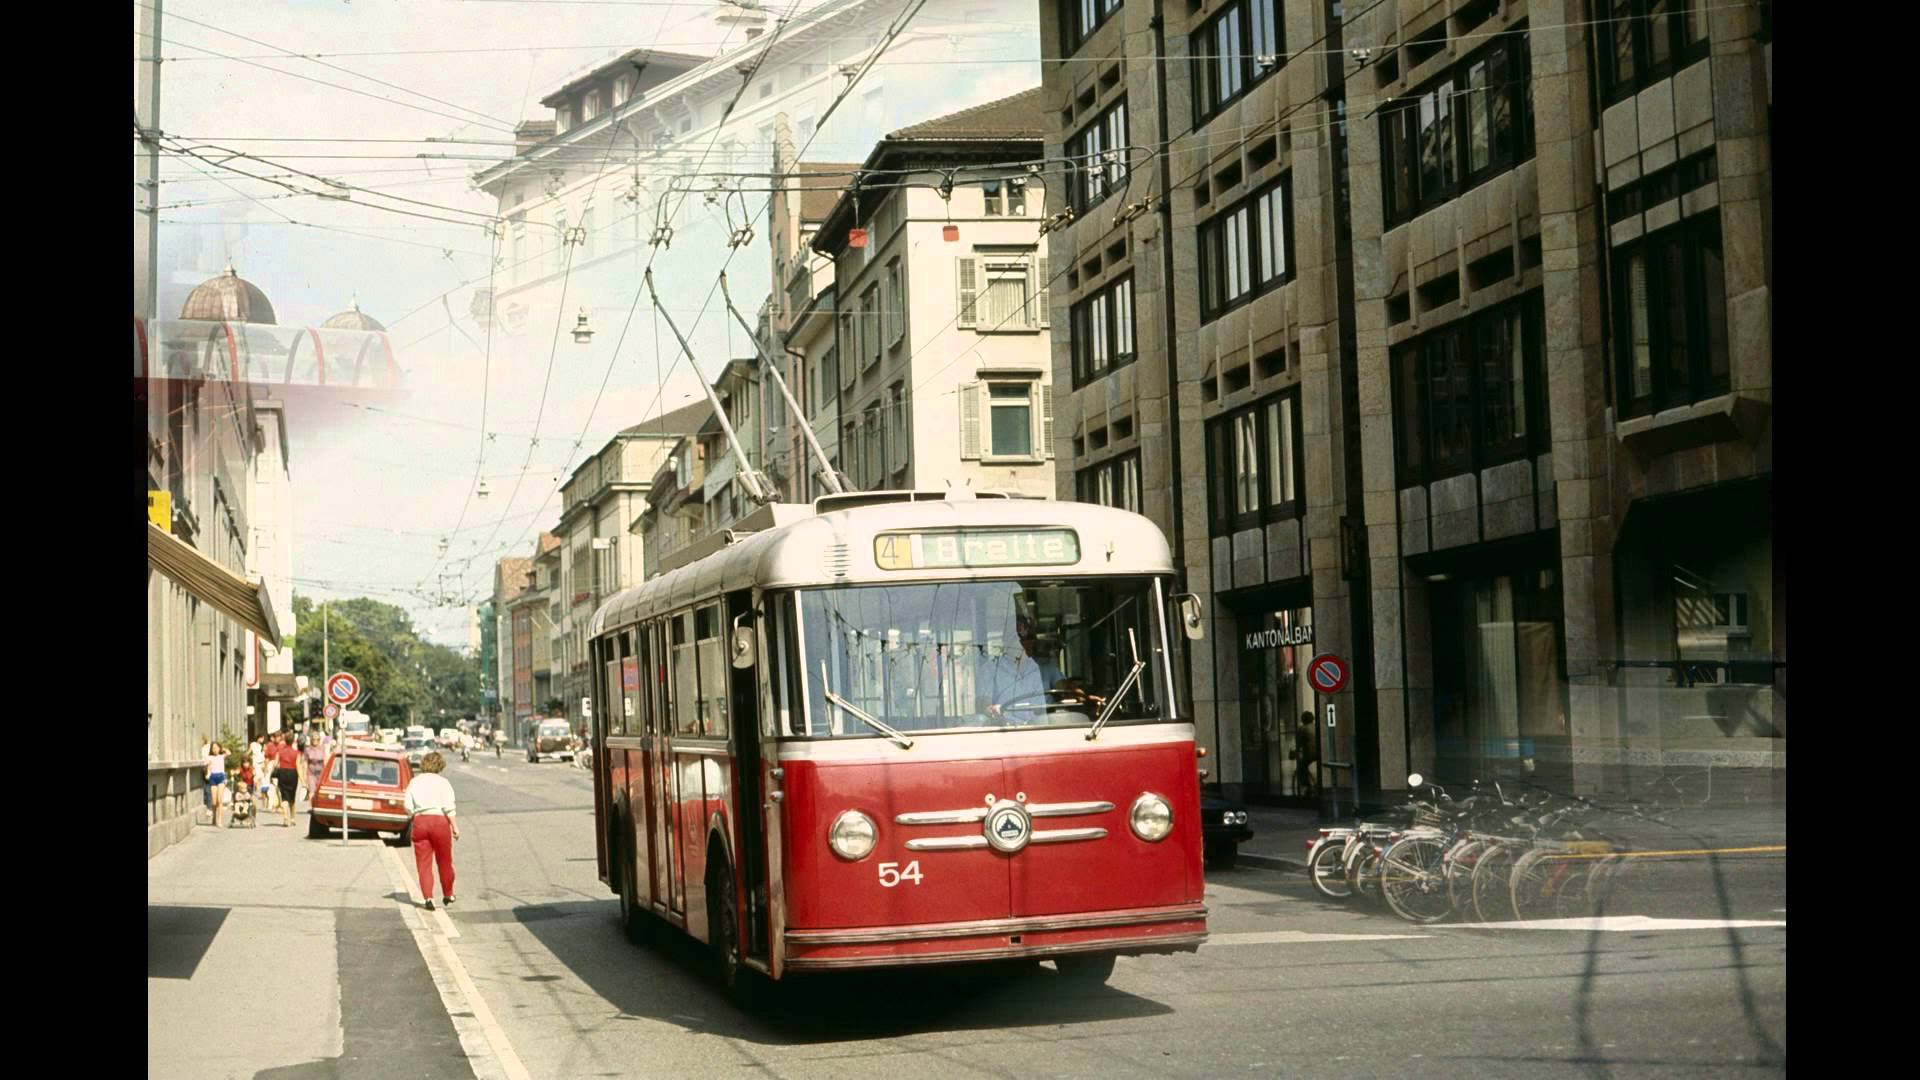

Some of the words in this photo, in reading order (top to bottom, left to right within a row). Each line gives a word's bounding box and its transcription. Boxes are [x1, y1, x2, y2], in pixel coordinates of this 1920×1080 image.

[881, 536, 899, 565] 4
[936, 533, 1065, 562] Breite
[878, 860, 924, 887] 54
